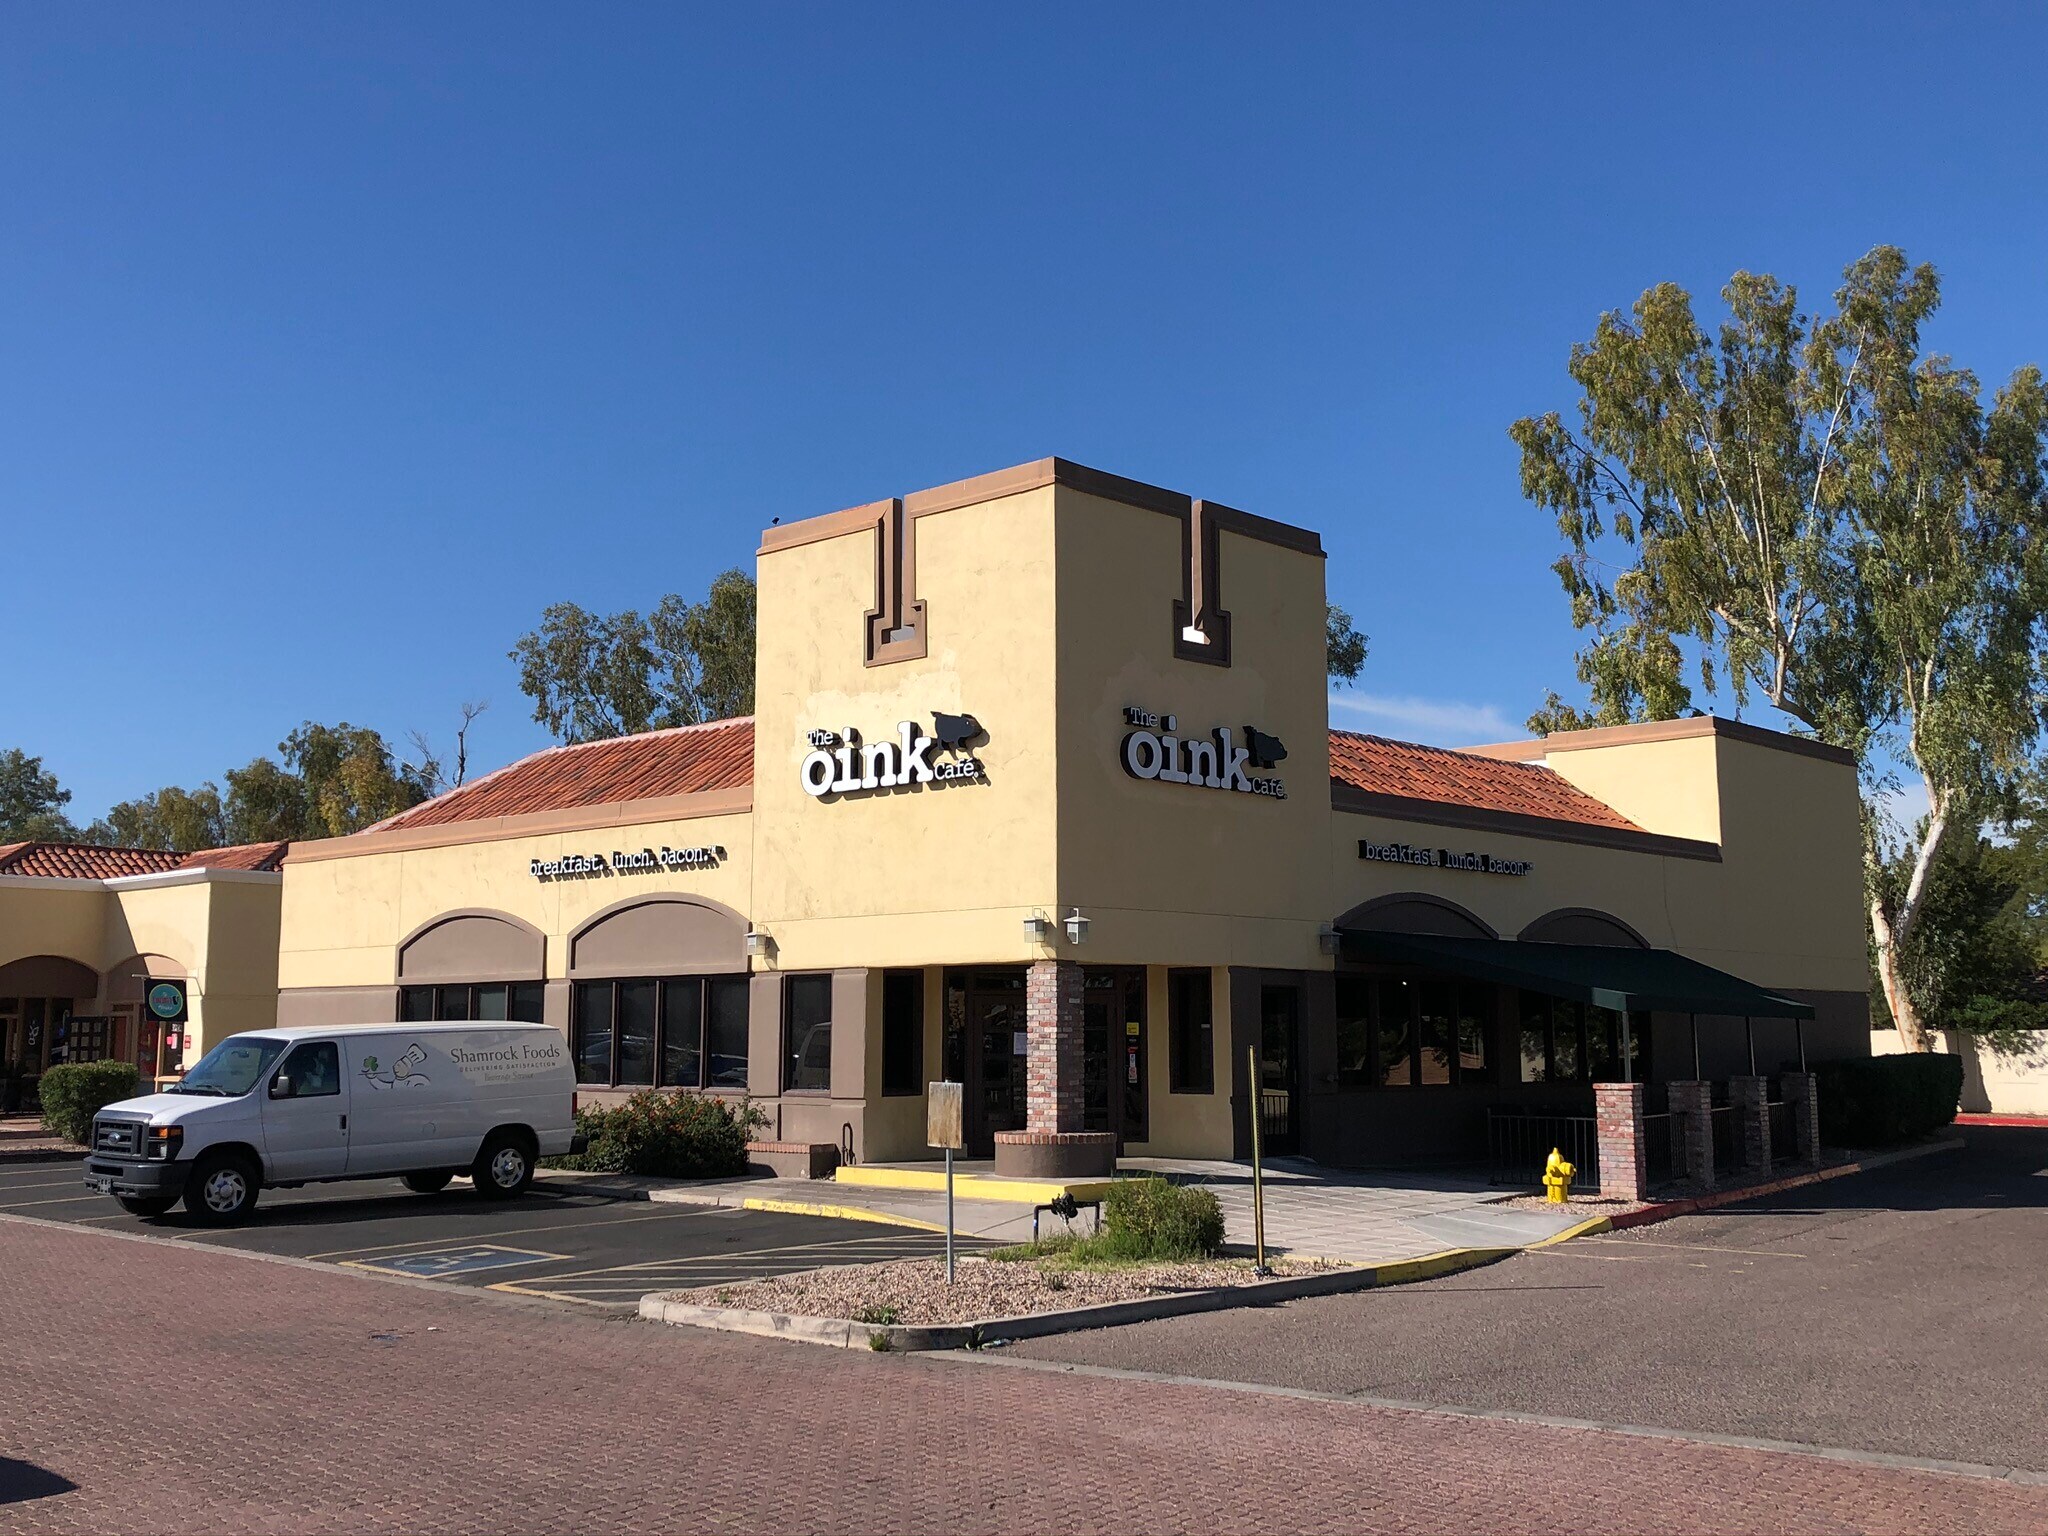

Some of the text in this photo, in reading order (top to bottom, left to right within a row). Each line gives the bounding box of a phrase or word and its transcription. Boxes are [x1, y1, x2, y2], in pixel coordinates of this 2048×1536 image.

[1131, 707, 1159, 727] The
[807, 728, 835, 747] The
[450, 1044, 561, 1064] Shamrock Foods
[459, 1061, 556, 1073] DELIVERING SATISFACTION
